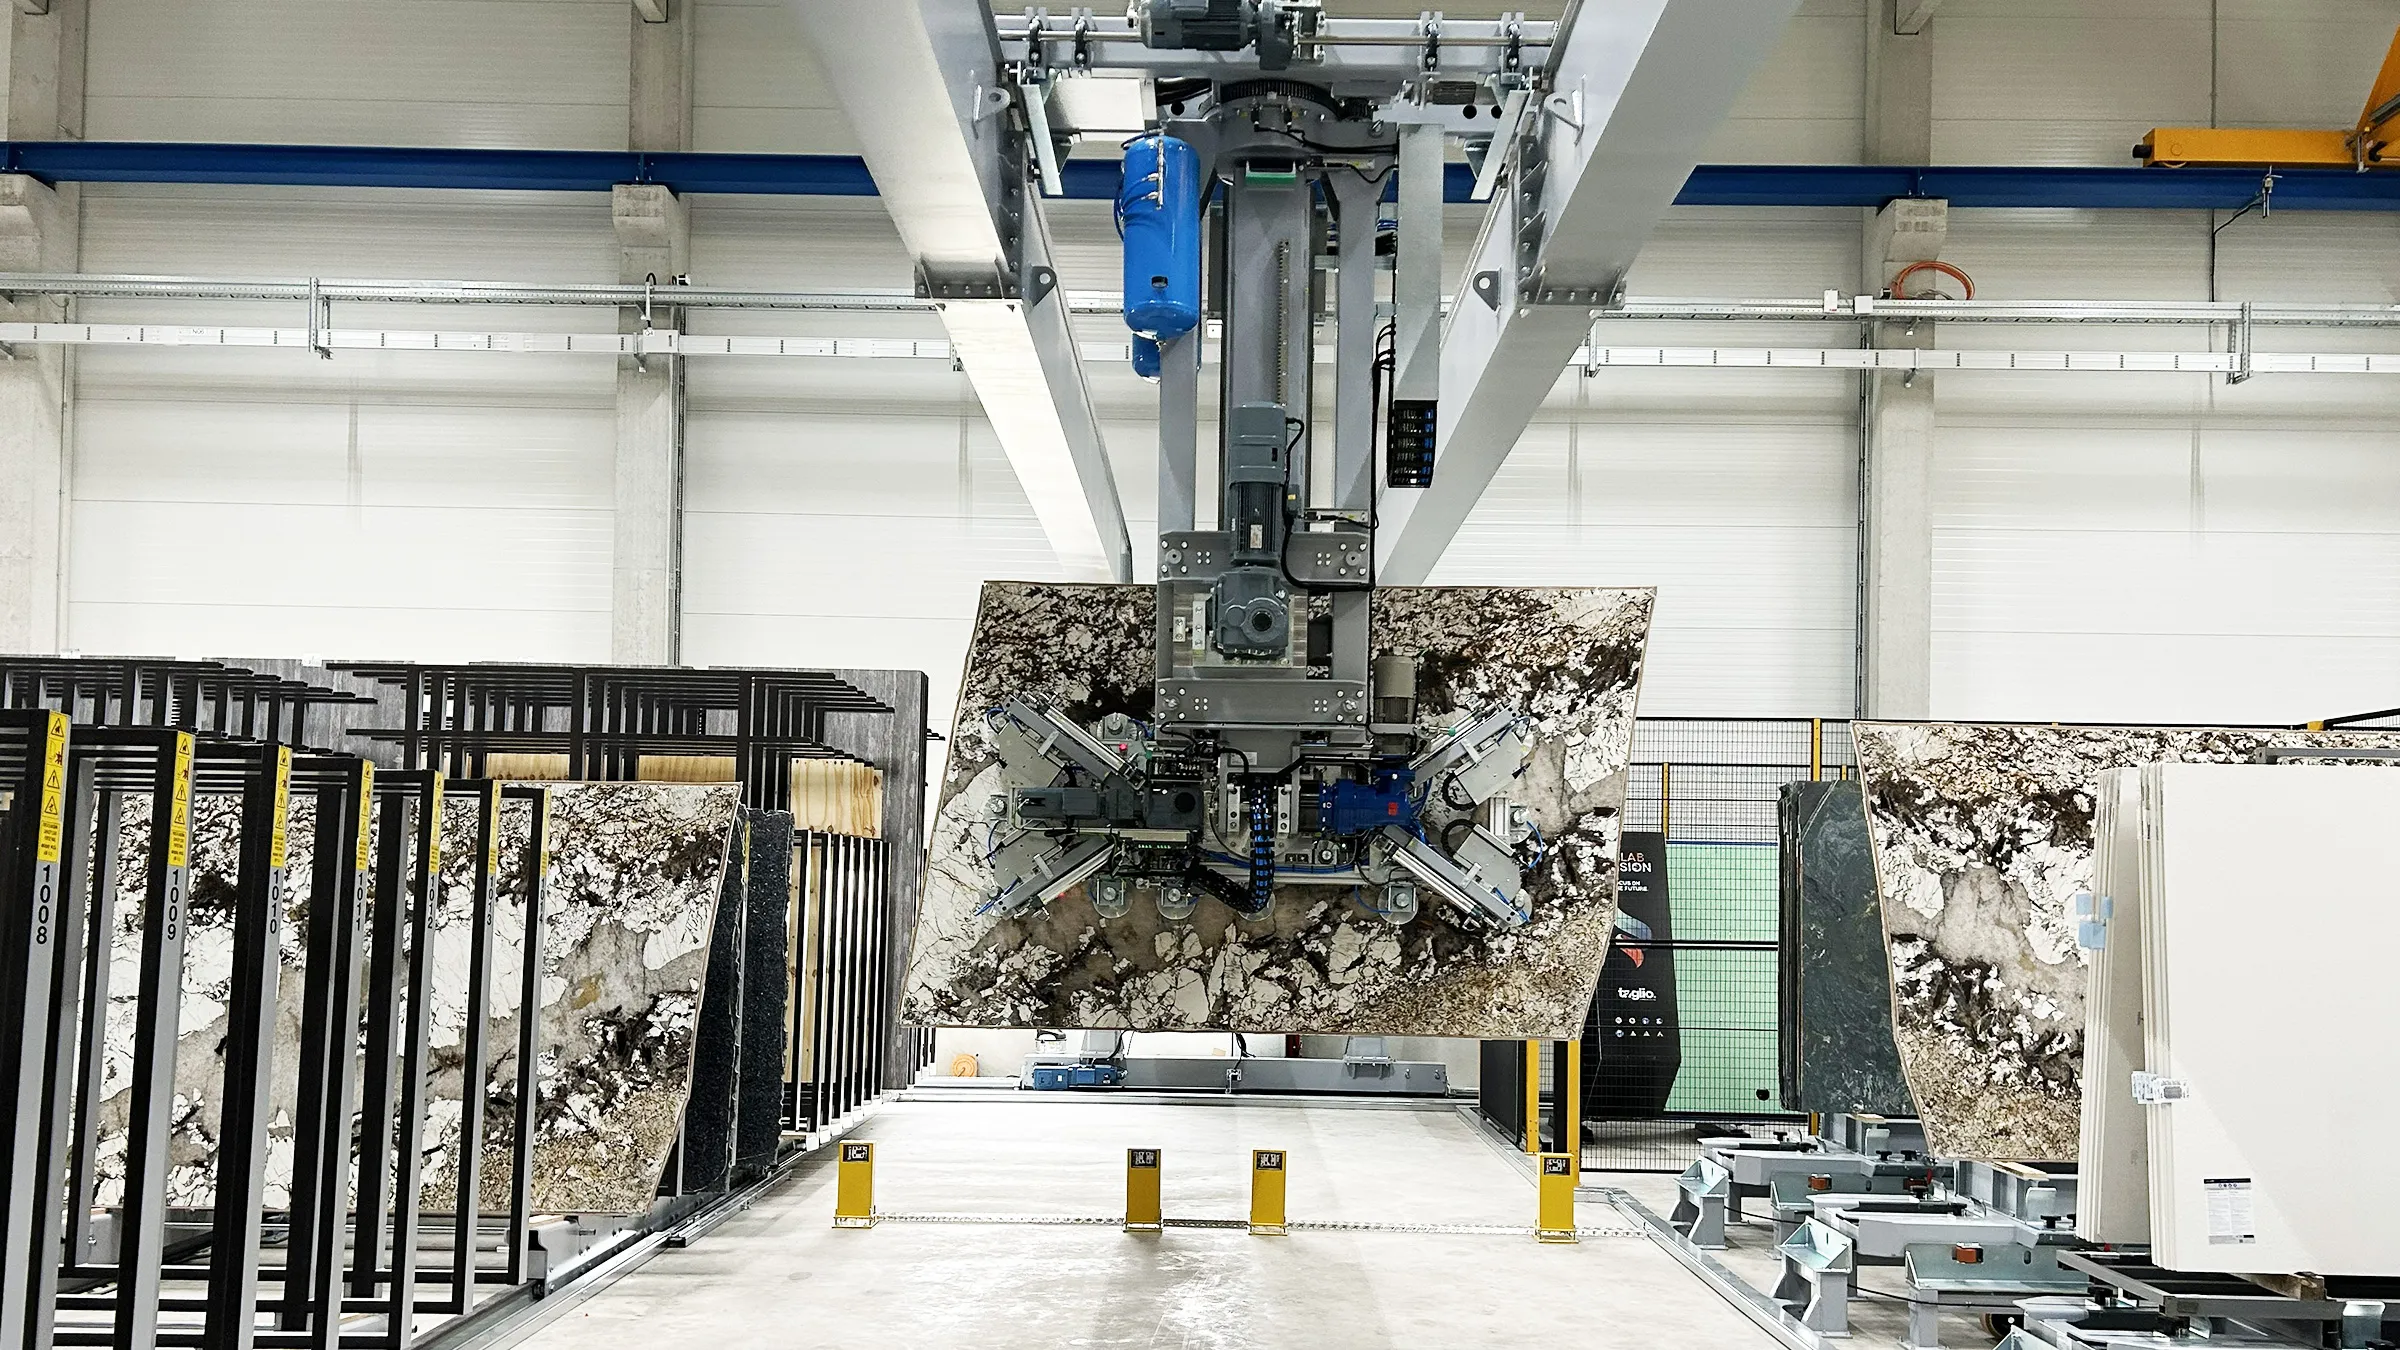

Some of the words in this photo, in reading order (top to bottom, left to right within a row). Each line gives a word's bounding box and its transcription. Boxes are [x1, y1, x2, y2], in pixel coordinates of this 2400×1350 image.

[1619, 862, 1652, 873] SION
[1620, 852, 1645, 862] LAB
[36, 864, 51, 945] 1008
[167, 869, 179, 940] 1009
[270, 869, 279, 934] 1010
[427, 874, 435, 929] 1012
[486, 876, 494, 926] 1013
